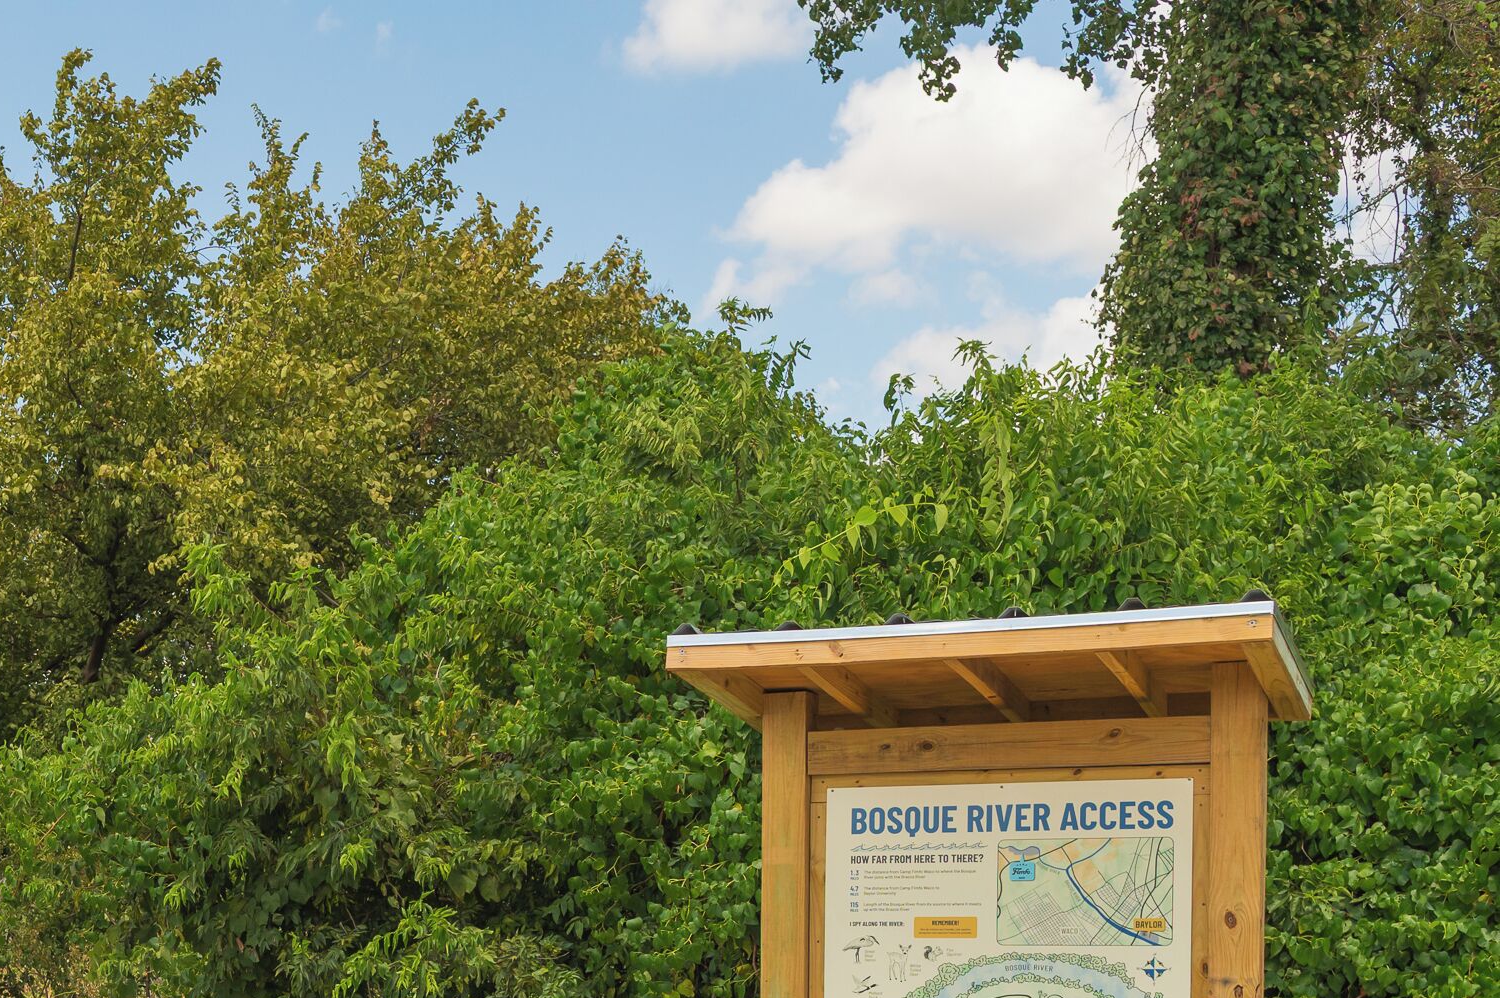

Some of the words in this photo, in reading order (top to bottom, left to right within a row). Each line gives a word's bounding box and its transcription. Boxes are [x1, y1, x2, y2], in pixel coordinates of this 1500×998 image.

[851, 805, 958, 838] BOSQUE
[967, 803, 1050, 832] RIVER
[1060, 800, 1174, 831] ACCESS
[850, 855, 869, 864] HOW
[872, 855, 887, 864] FAR
[889, 854, 912, 864] FROM
[914, 854, 936, 864] HERE
[938, 854, 948, 863] TO
[952, 853, 984, 863] THERE?
[1135, 920, 1163, 929] BAYLOR
